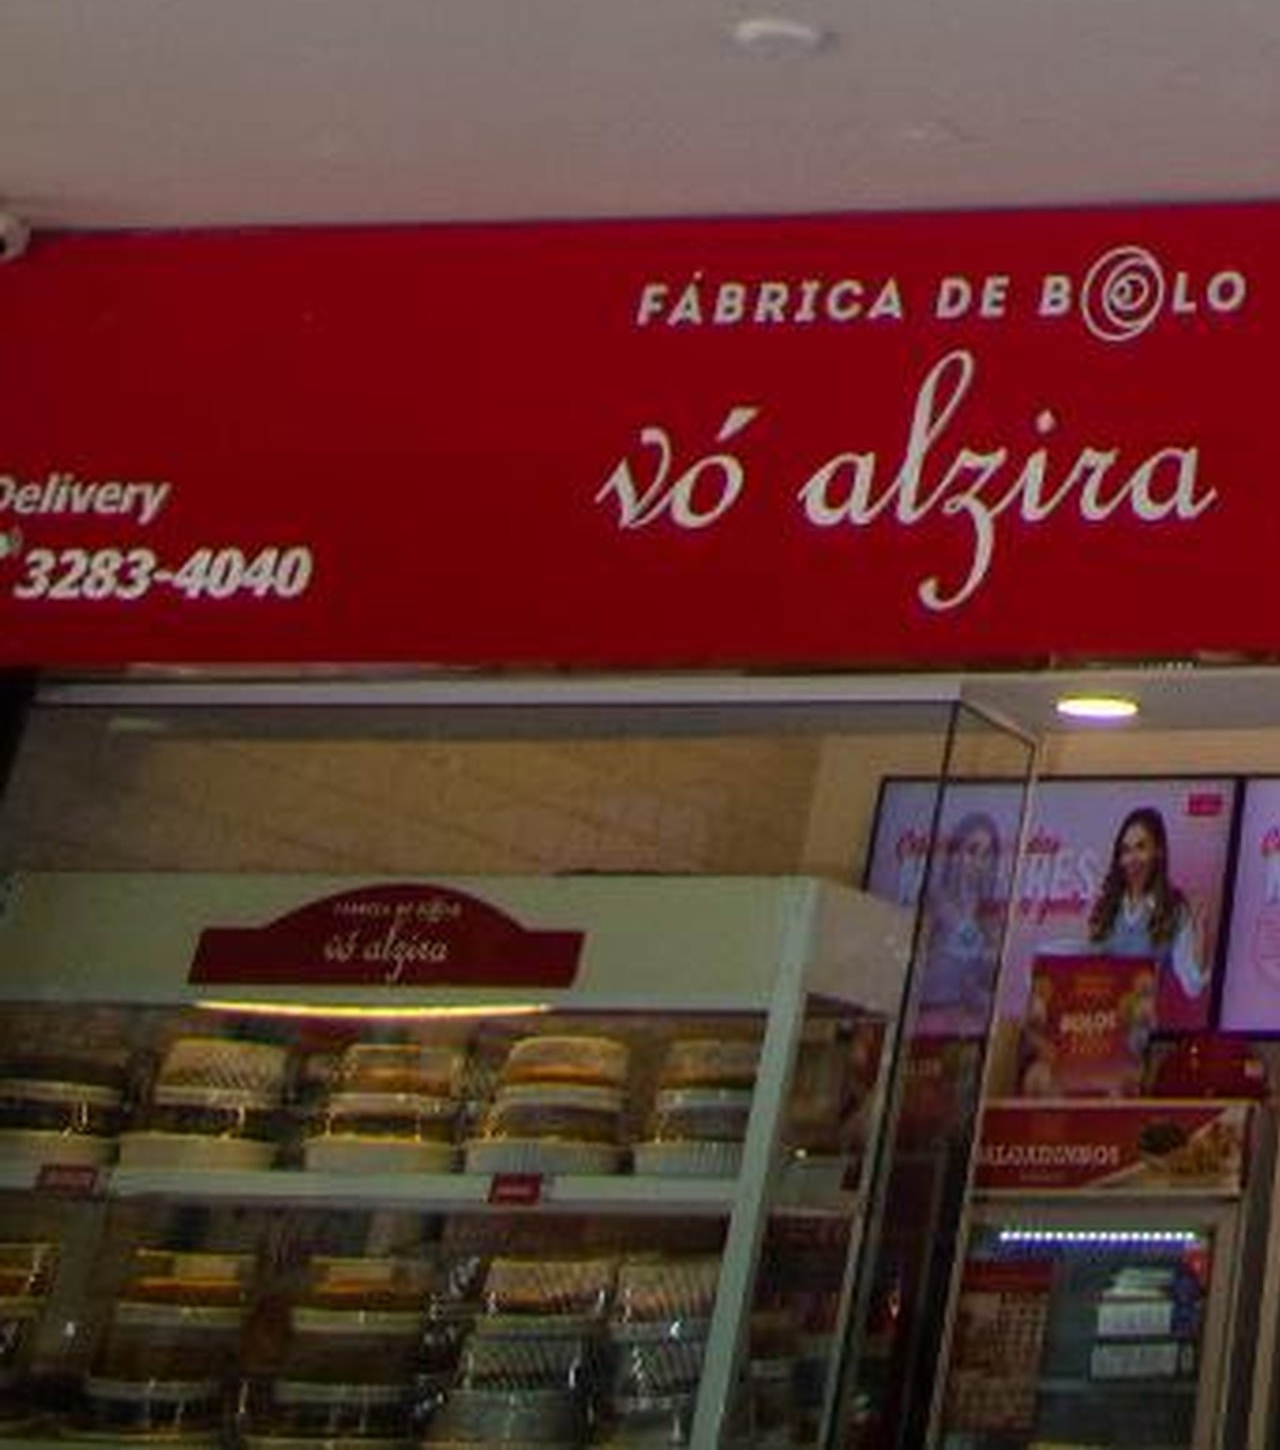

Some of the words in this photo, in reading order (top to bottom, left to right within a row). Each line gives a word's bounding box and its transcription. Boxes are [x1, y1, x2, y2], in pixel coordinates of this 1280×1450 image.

[636, 271, 905, 327] FÁBRICA
[935, 276, 1009, 321] DE
[595, 405, 760, 530] vó
[798, 350, 1217, 612] alzira
[14, 545, 314, 600] 3283-4040
